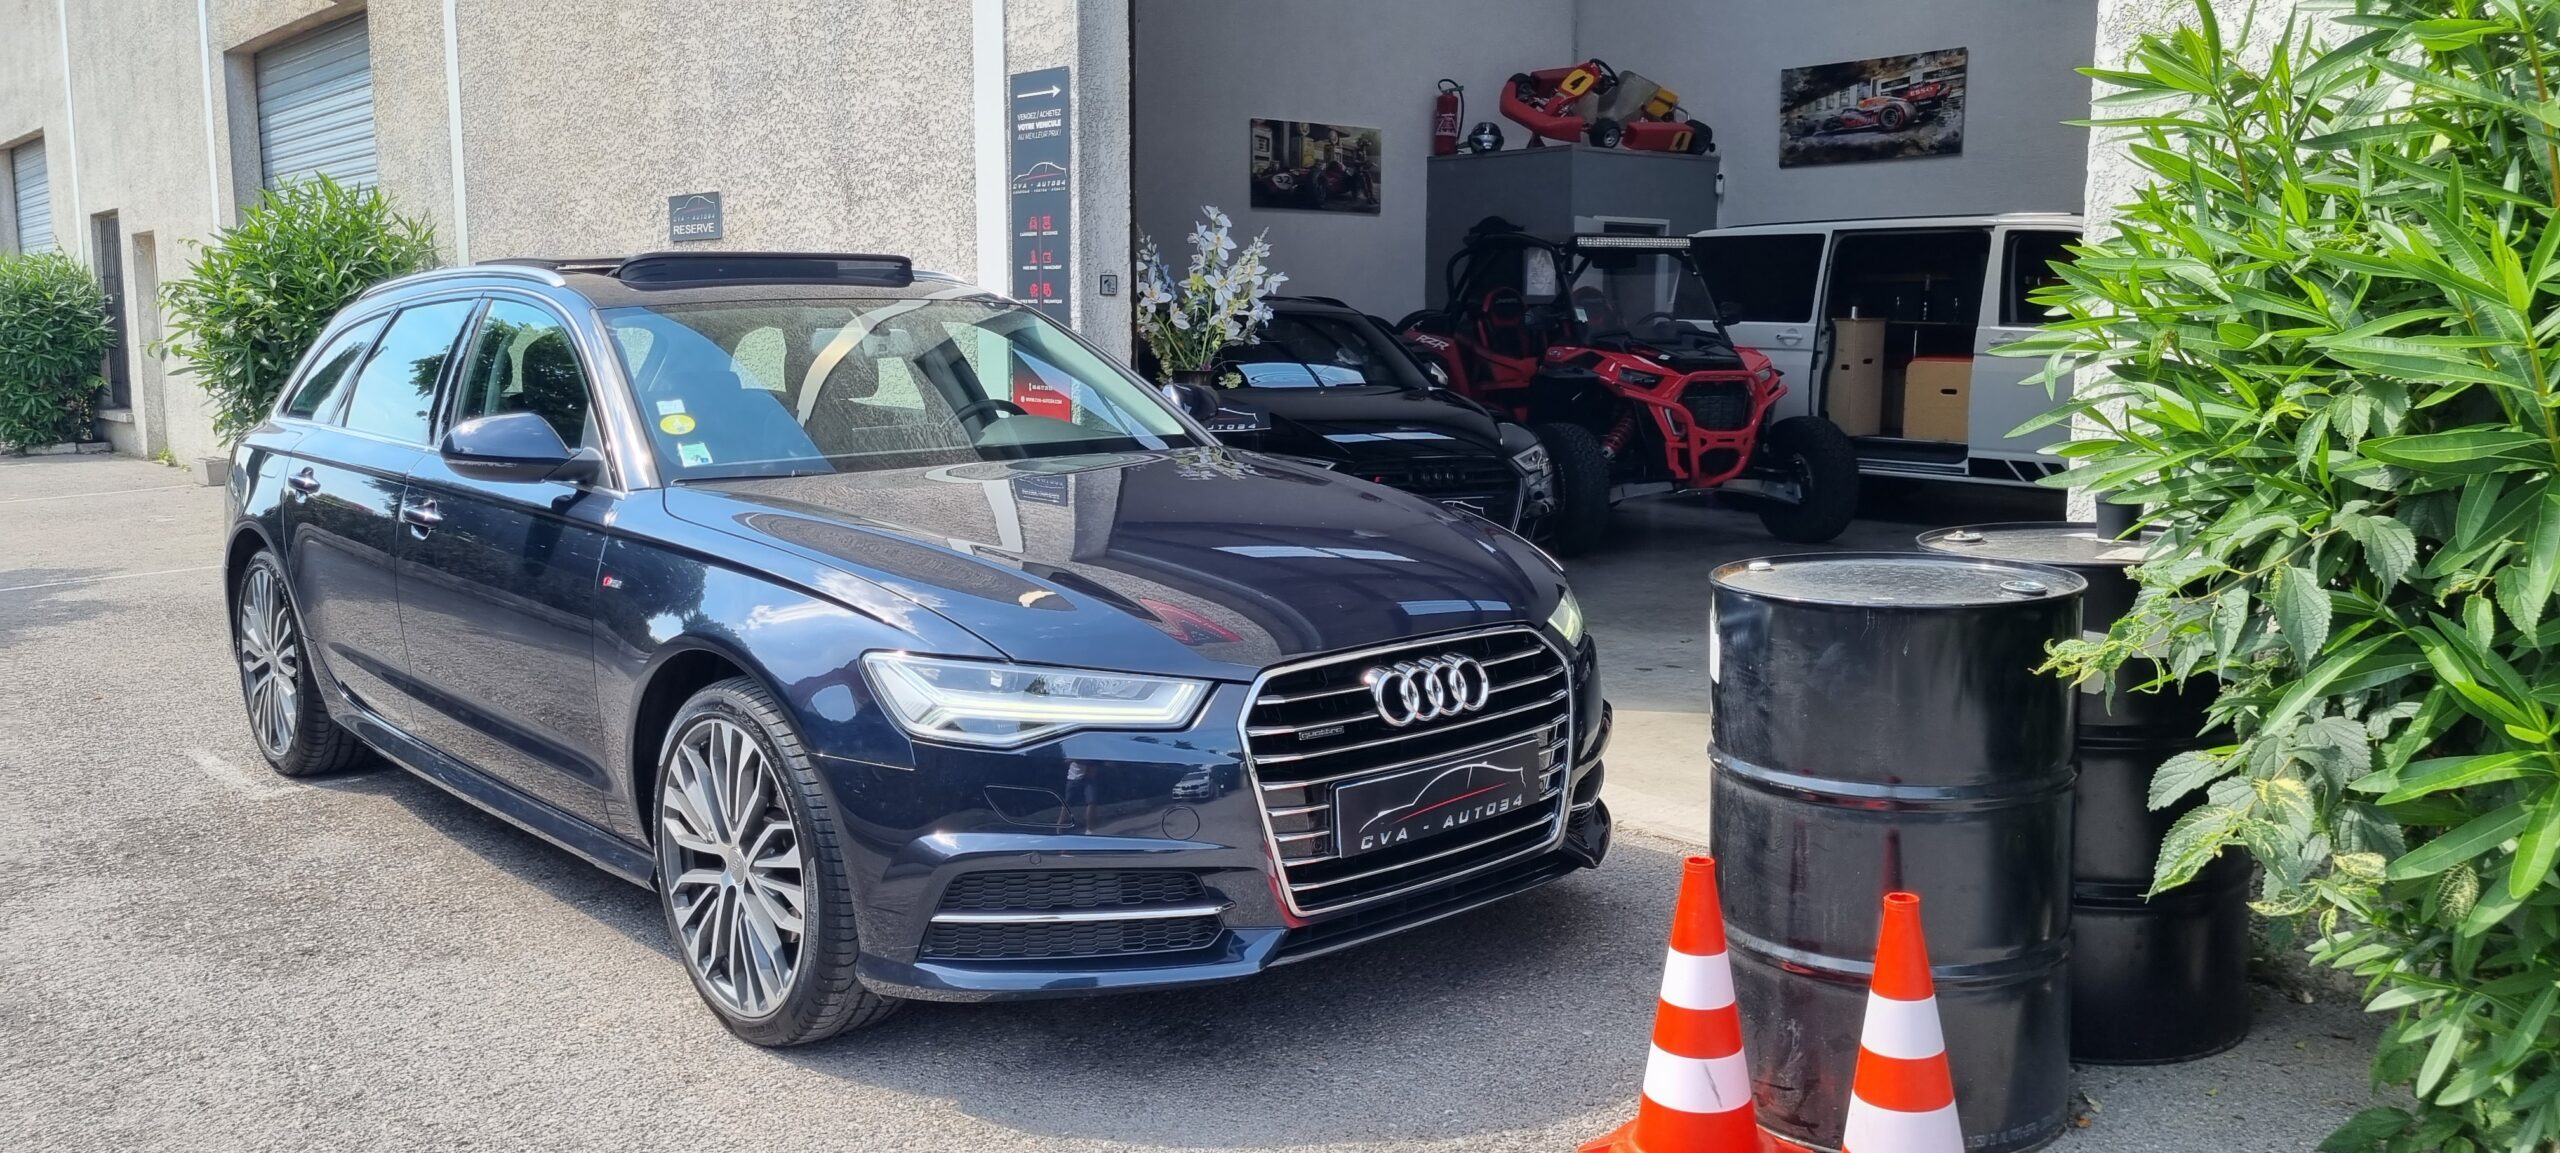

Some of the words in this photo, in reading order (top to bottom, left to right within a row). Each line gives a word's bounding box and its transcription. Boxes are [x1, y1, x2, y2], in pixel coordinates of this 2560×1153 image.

[673, 223, 715, 235] RESERVE
[1416, 334, 1450, 351] RZR
[1361, 827, 1408, 850] CVA
[1443, 794, 1523, 828] AUTO34
